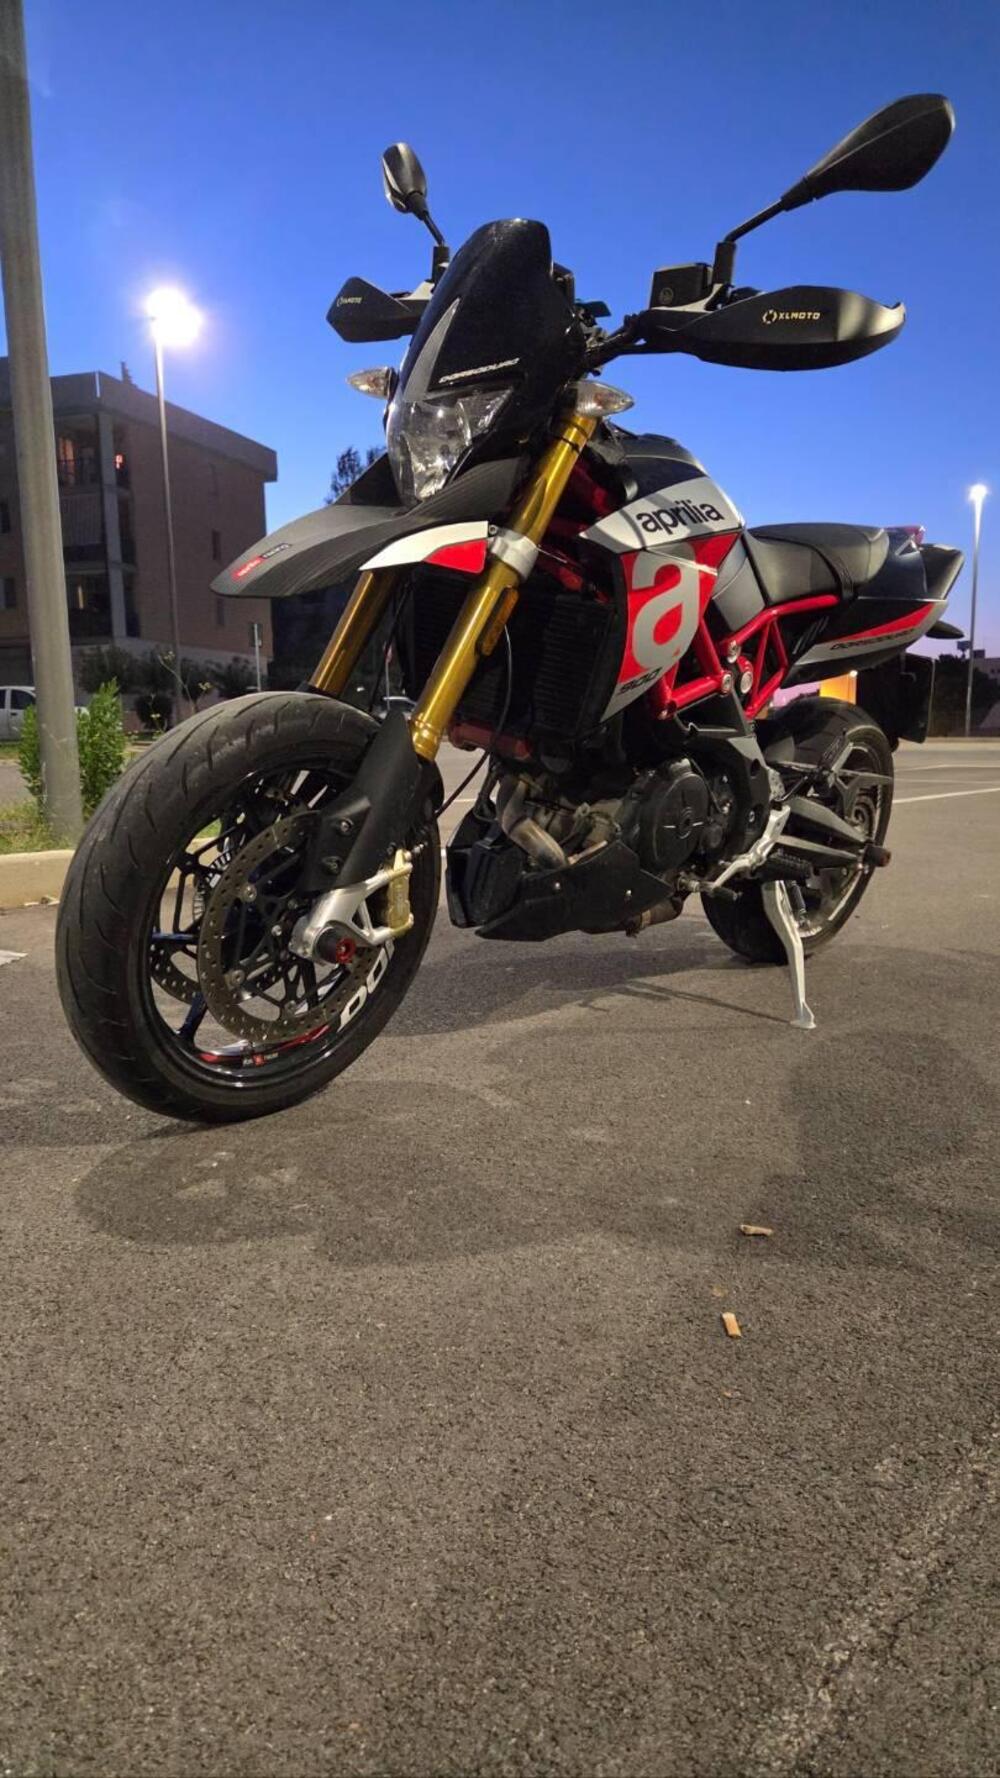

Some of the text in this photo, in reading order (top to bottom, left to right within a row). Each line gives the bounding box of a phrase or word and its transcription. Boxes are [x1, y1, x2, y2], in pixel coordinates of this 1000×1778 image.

[779, 311, 821, 320] XLMOTO
[636, 499, 725, 535] aprilia
[632, 540, 700, 671] a
